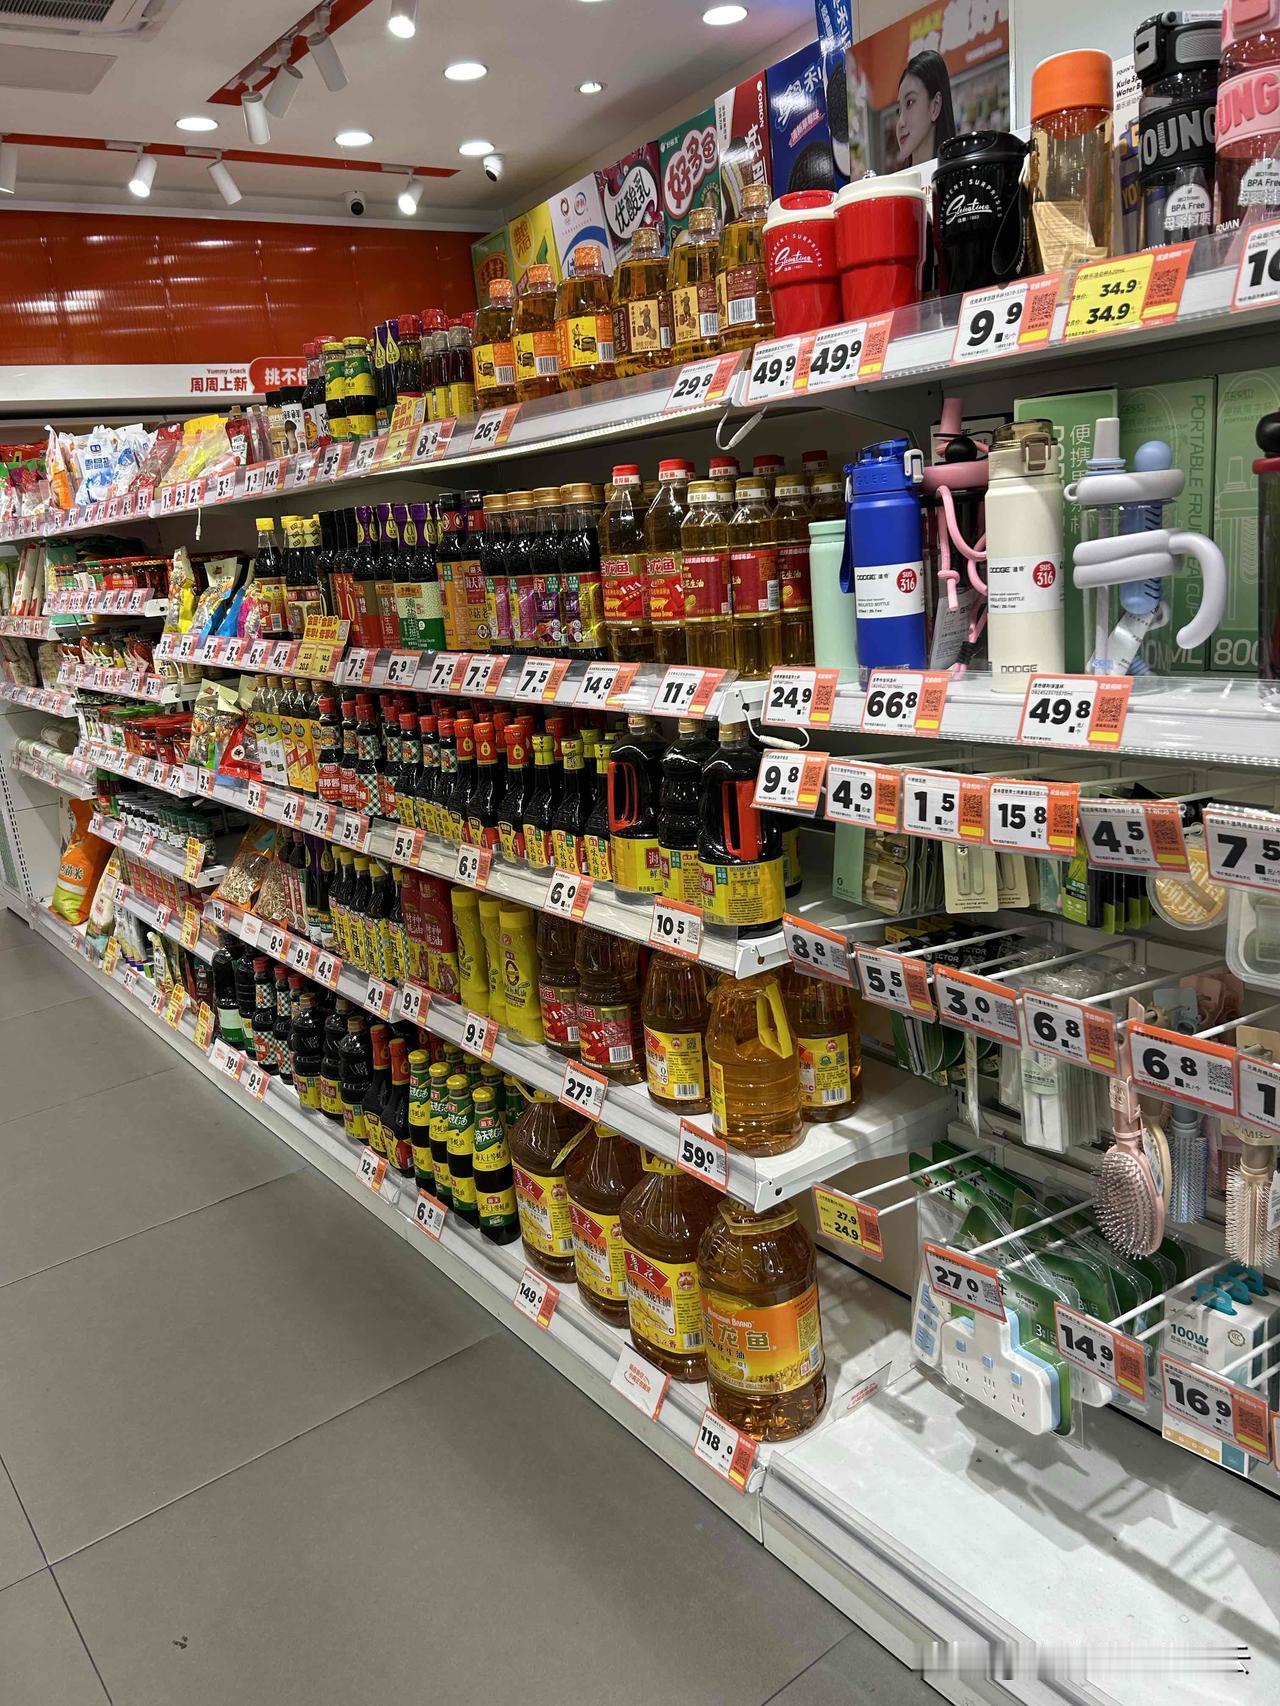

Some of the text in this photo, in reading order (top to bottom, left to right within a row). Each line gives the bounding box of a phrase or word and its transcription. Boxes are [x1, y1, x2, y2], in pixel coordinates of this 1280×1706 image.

[1116, 84, 1136, 98] Water
[1117, 77, 1131, 89] Kule
[667, 130, 717, 208] 好多鱼
[1247, 178, 1264, 187] BPA
[615, 168, 651, 234] 优酸乳
[1171, 201, 1206, 212] BPA Free
[1099, 279, 1138, 297] 34.9
[967, 301, 1023, 347] 9.9
[1085, 303, 1132, 325] 34.9
[810, 340, 862, 375] 49.9
[753, 355, 796, 387] 49.9
[190, 377, 248, 392] 周周上新
[673, 373, 713, 399] 29.8
[475, 420, 500, 442] 26.8
[1188, 395, 1206, 488] PORTABLE
[417, 432, 438, 456] 8.8
[323, 453, 339, 475] 3.5
[900, 577, 915, 592] 316
[1036, 571, 1054, 586] 316
[1186, 583, 1200, 617] CUP
[273, 651, 288, 668] 4.5
[350, 658, 365, 678] 7.5
[388, 660, 406, 680] 6.9
[1001, 664, 1038, 673] DODGE
[432, 664, 453, 685] 7.5
[466, 665, 489, 687] 7.5
[521, 670, 549, 693] 7.5
[584, 676, 613, 700] 14.8
[663, 682, 695, 705] 11.8
[771, 686, 812, 715] 24.9
[867, 691, 918, 719] 66.8
[1029, 698, 1091, 733] 49.8
[763, 766, 800, 795] 9.8
[832, 780, 872, 813] 4.9
[914, 791, 955, 826] 1.5
[283, 802, 296, 821] 4.8
[314, 811, 328, 830] 7.9
[998, 803, 1047, 838] 15.8
[344, 822, 359, 842] 5.9
[1092, 820, 1145, 855] 4.5
[394, 836, 412, 858] 5.9
[1217, 833, 1280, 876] 7.5
[459, 855, 477, 879] 6.8
[551, 882, 575, 908] 6.0
[657, 915, 684, 944] 10.5
[298, 948, 309, 965] 9.8
[791, 934, 826, 964] 8.8
[318, 961, 332, 979] 4.8
[866, 965, 902, 997] 5.5
[368, 987, 383, 1008] 4.9
[403, 992, 419, 1014] 9.8
[946, 987, 990, 1023] 3.0
[464, 1023, 483, 1047] 9.5
[1033, 1011, 1081, 1049] 6.8
[1143, 1048, 1198, 1088] 6.8
[249, 1072, 261, 1091] 9.8
[565, 1078, 592, 1105] 27.9
[681, 1140, 714, 1173] 59.0
[361, 1159, 376, 1181] 12.8
[417, 1206, 433, 1227] 6.5
[836, 1210, 857, 1225] 27.9
[834, 1222, 859, 1241] 24.9
[934, 1264, 980, 1301] 27.0
[519, 1282, 542, 1309] 149.0
[731, 1318, 753, 1329] BRAND
[1060, 1323, 1114, 1368] 14.9
[1171, 1324, 1209, 1348] 100W
[1168, 1377, 1231, 1425] 16.9
[701, 1425, 733, 1461] 118.0
